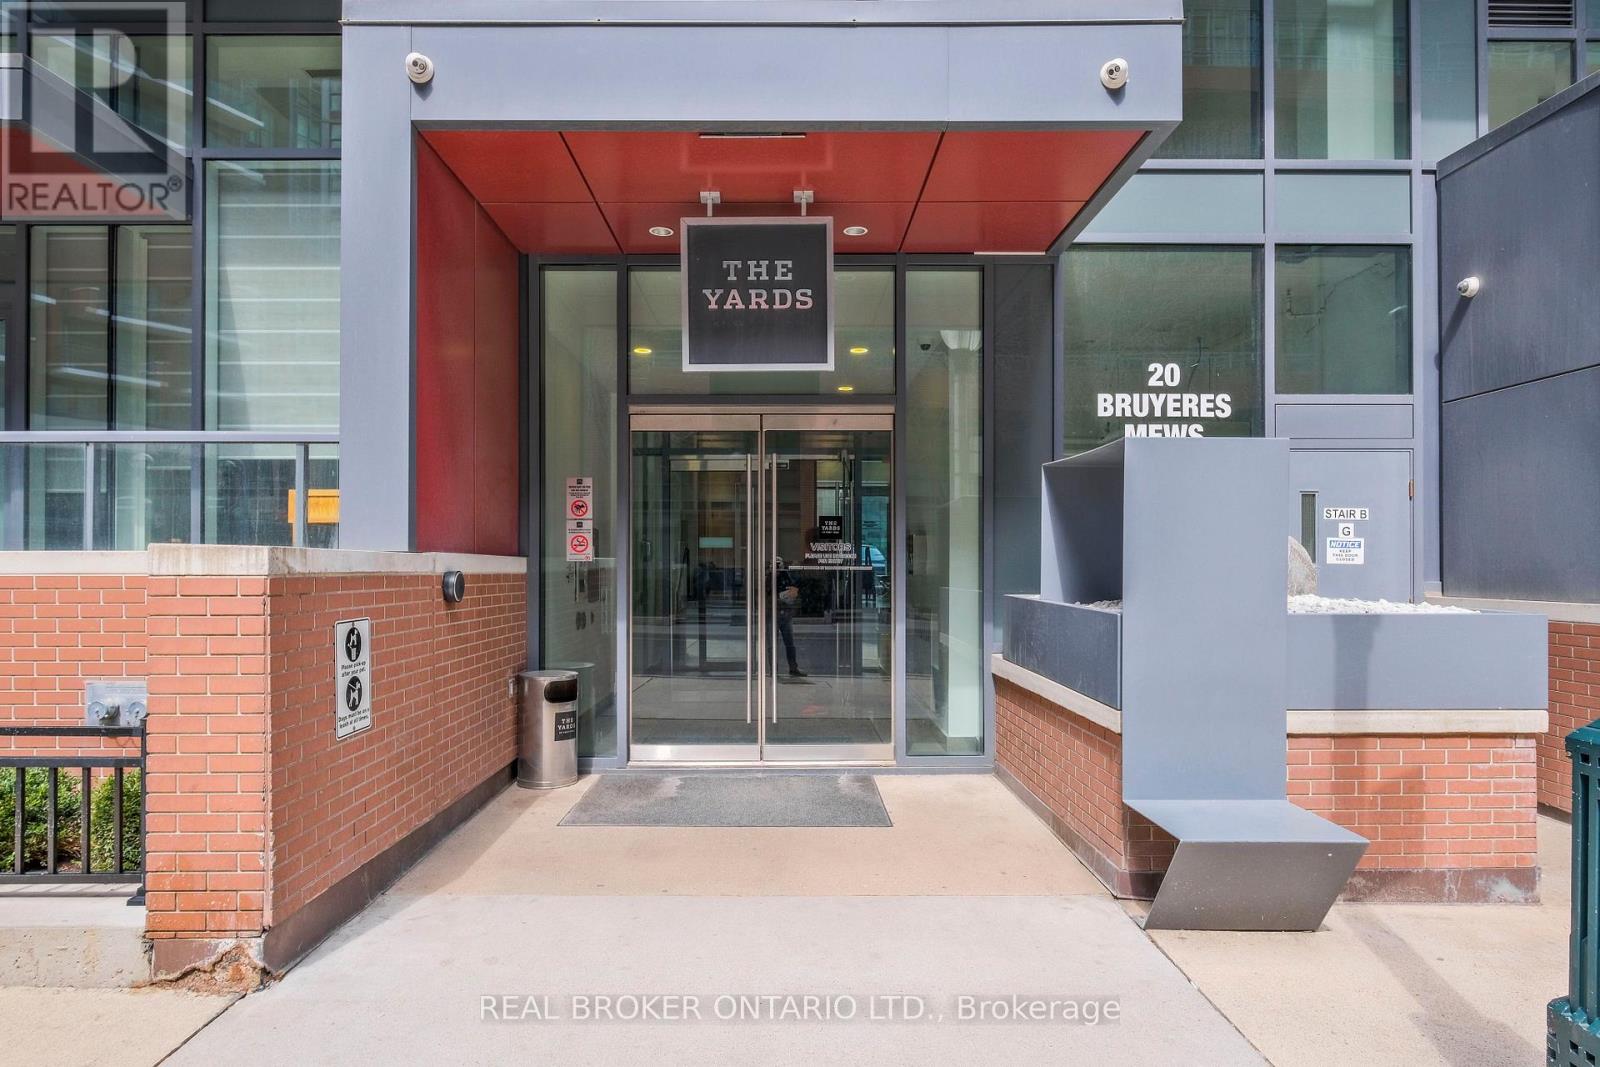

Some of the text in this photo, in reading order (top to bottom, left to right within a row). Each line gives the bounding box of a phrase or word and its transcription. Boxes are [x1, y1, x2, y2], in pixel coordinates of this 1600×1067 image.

[722, 260, 793, 281] THE
[702, 289, 814, 310] YARDS
[1147, 362, 1181, 387] 20
[1097, 393, 1232, 418] BRUYERES
[1325, 508, 1367, 519] STAIR B
[1342, 526, 1351, 537] G
[810, 542, 852, 552] VISITORS
[1330, 540, 1361, 548] NOTICE
